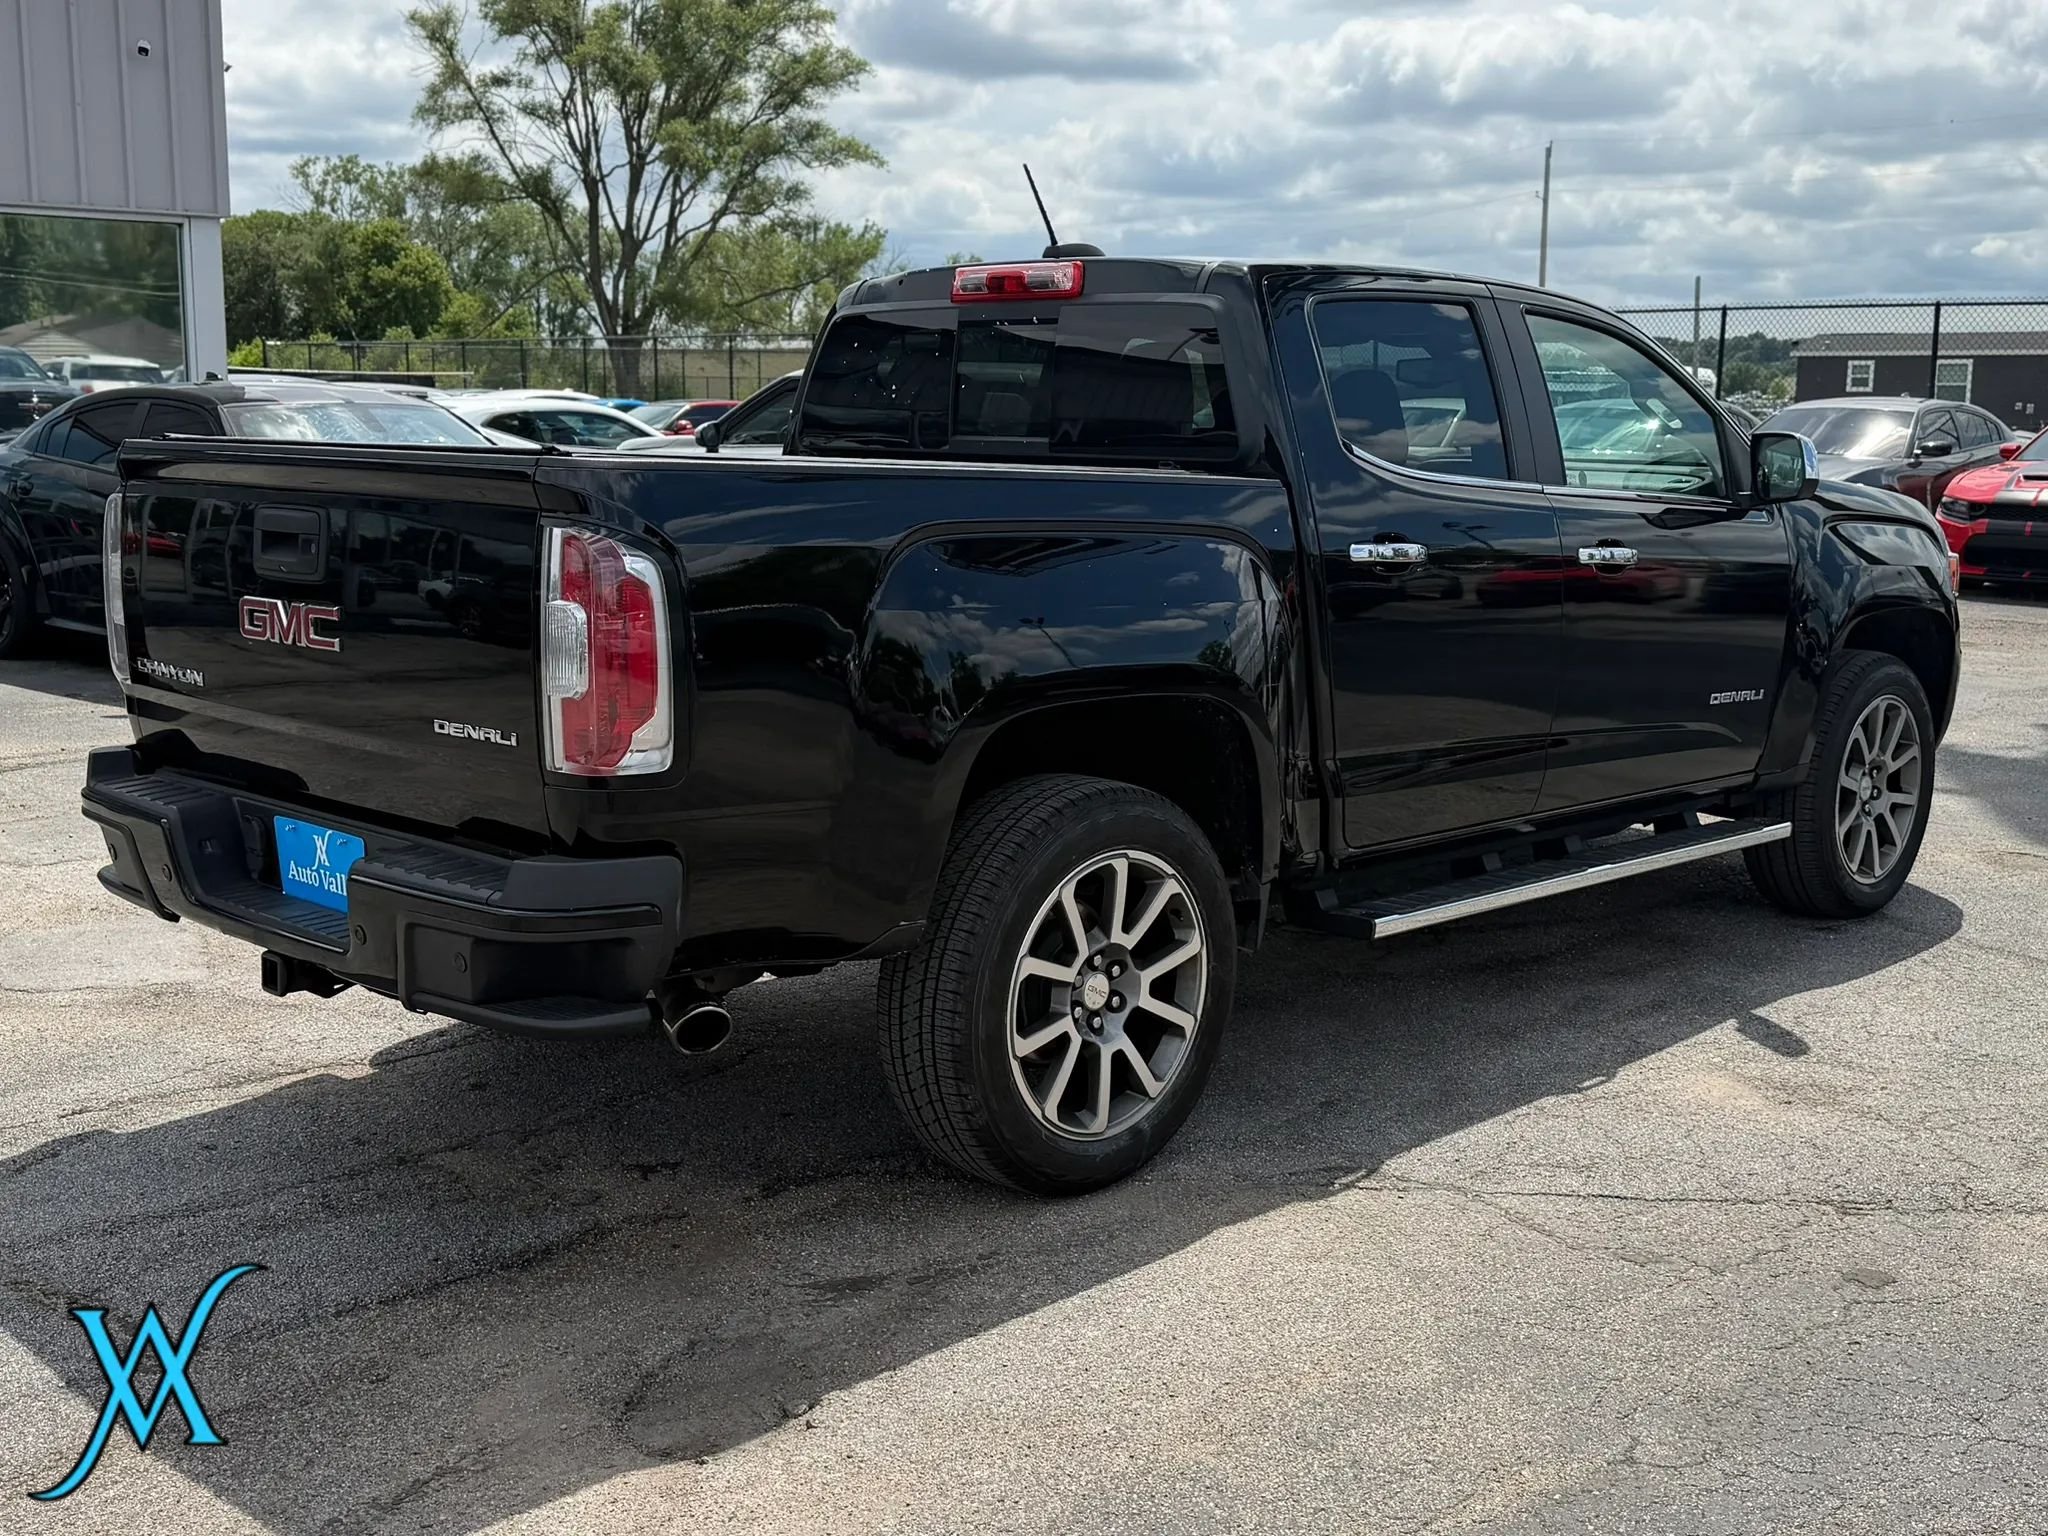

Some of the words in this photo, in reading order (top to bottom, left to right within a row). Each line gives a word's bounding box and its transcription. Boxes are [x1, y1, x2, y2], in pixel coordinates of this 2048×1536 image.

[238, 595, 340, 652] GMC
[137, 657, 204, 687] CANYON
[1710, 689, 1765, 705] DENALI
[433, 719, 518, 747] DENALI
[288, 860, 320, 887] Auto
[1088, 984, 1107, 998] GMC
